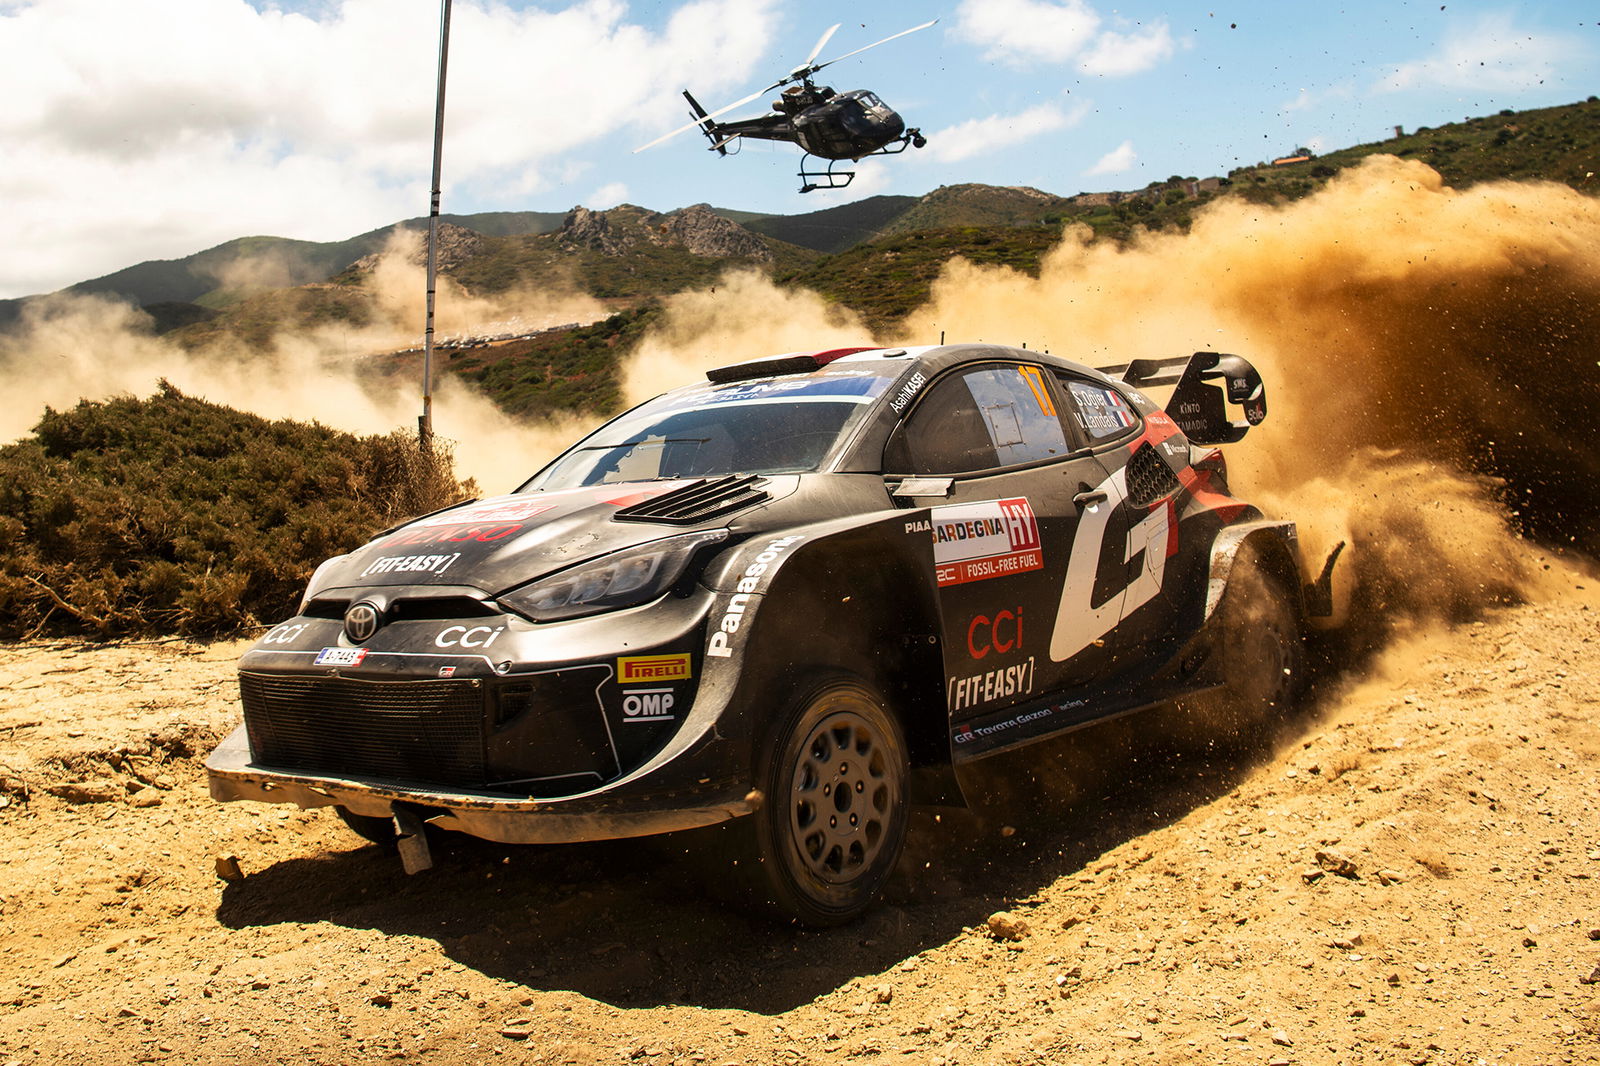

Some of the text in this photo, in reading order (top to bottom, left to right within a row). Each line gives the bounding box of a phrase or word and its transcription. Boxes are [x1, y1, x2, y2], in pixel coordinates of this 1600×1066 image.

[1017, 365, 1057, 417] 17
[904, 519, 932, 534] PIAA
[966, 556, 1019, 578] FOSSIL-FREE
[1019, 553, 1039, 568] FUEL
[624, 657, 687, 678] PIRELLI
[622, 693, 675, 716] OMP
